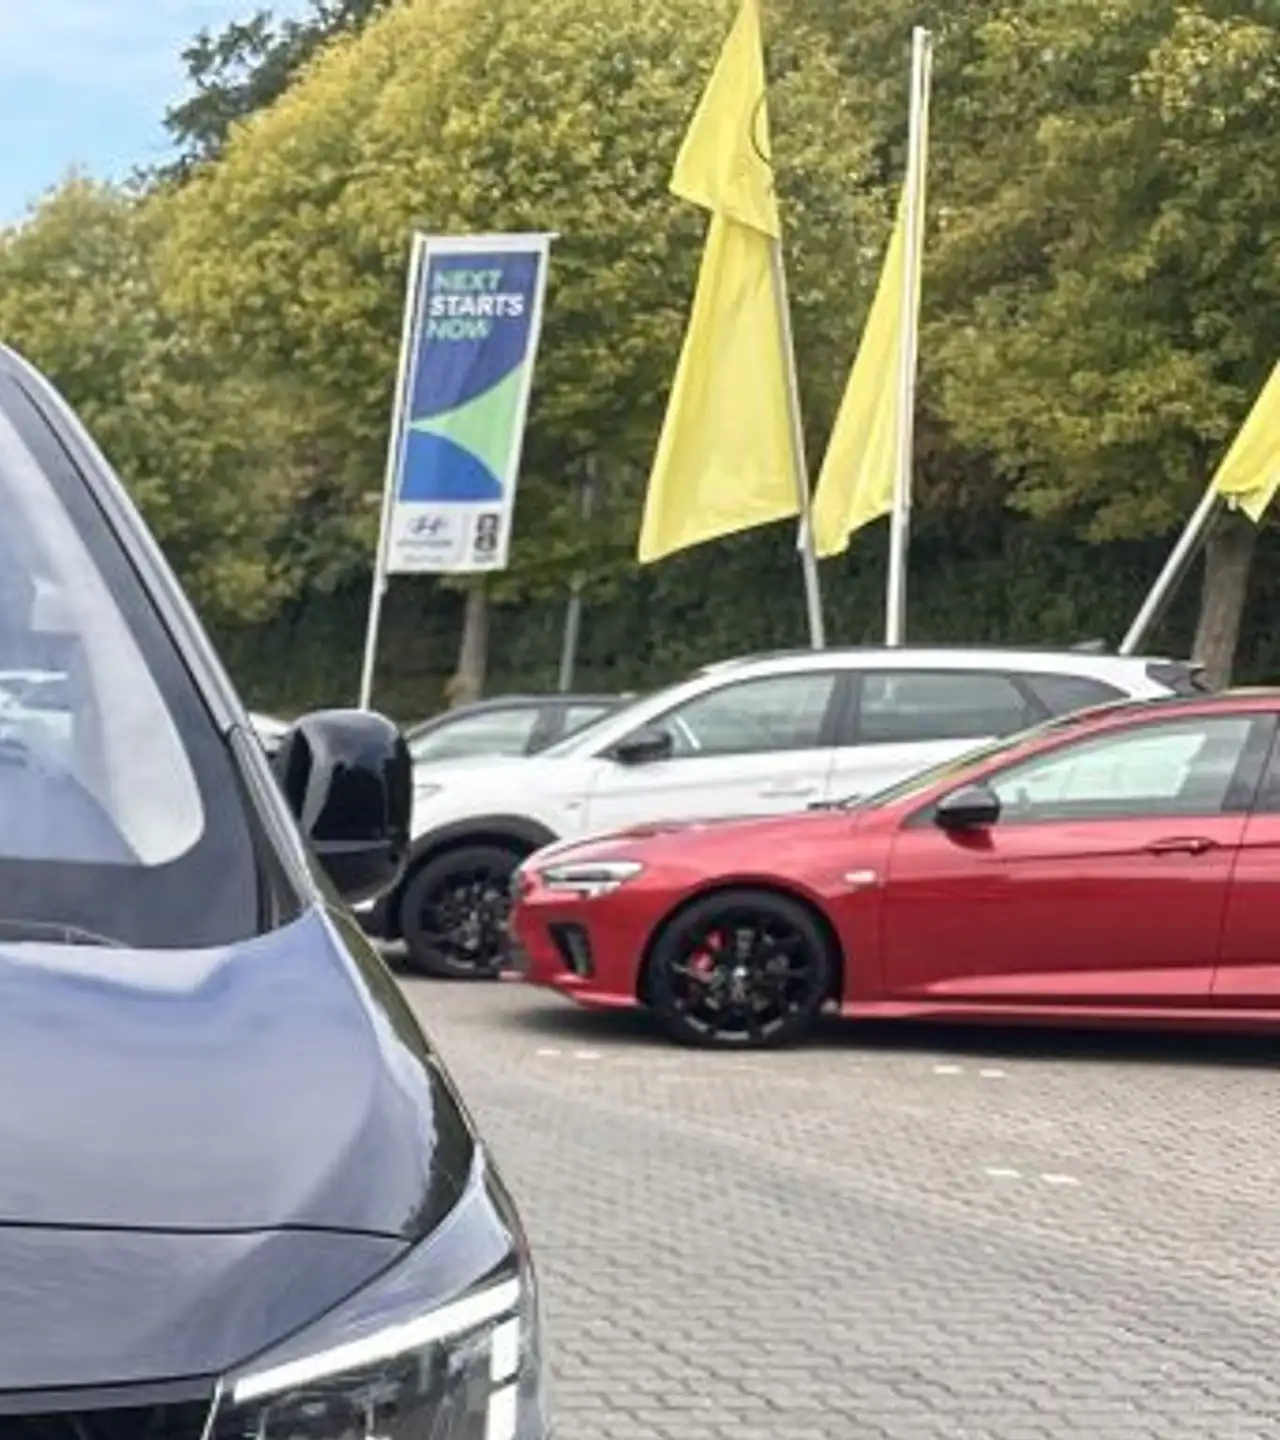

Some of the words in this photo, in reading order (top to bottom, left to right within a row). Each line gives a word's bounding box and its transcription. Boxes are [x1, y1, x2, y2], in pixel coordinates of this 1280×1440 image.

[433, 269, 503, 292] NEXT
[430, 293, 524, 317] STARTS
[426, 319, 491, 340] NOW
